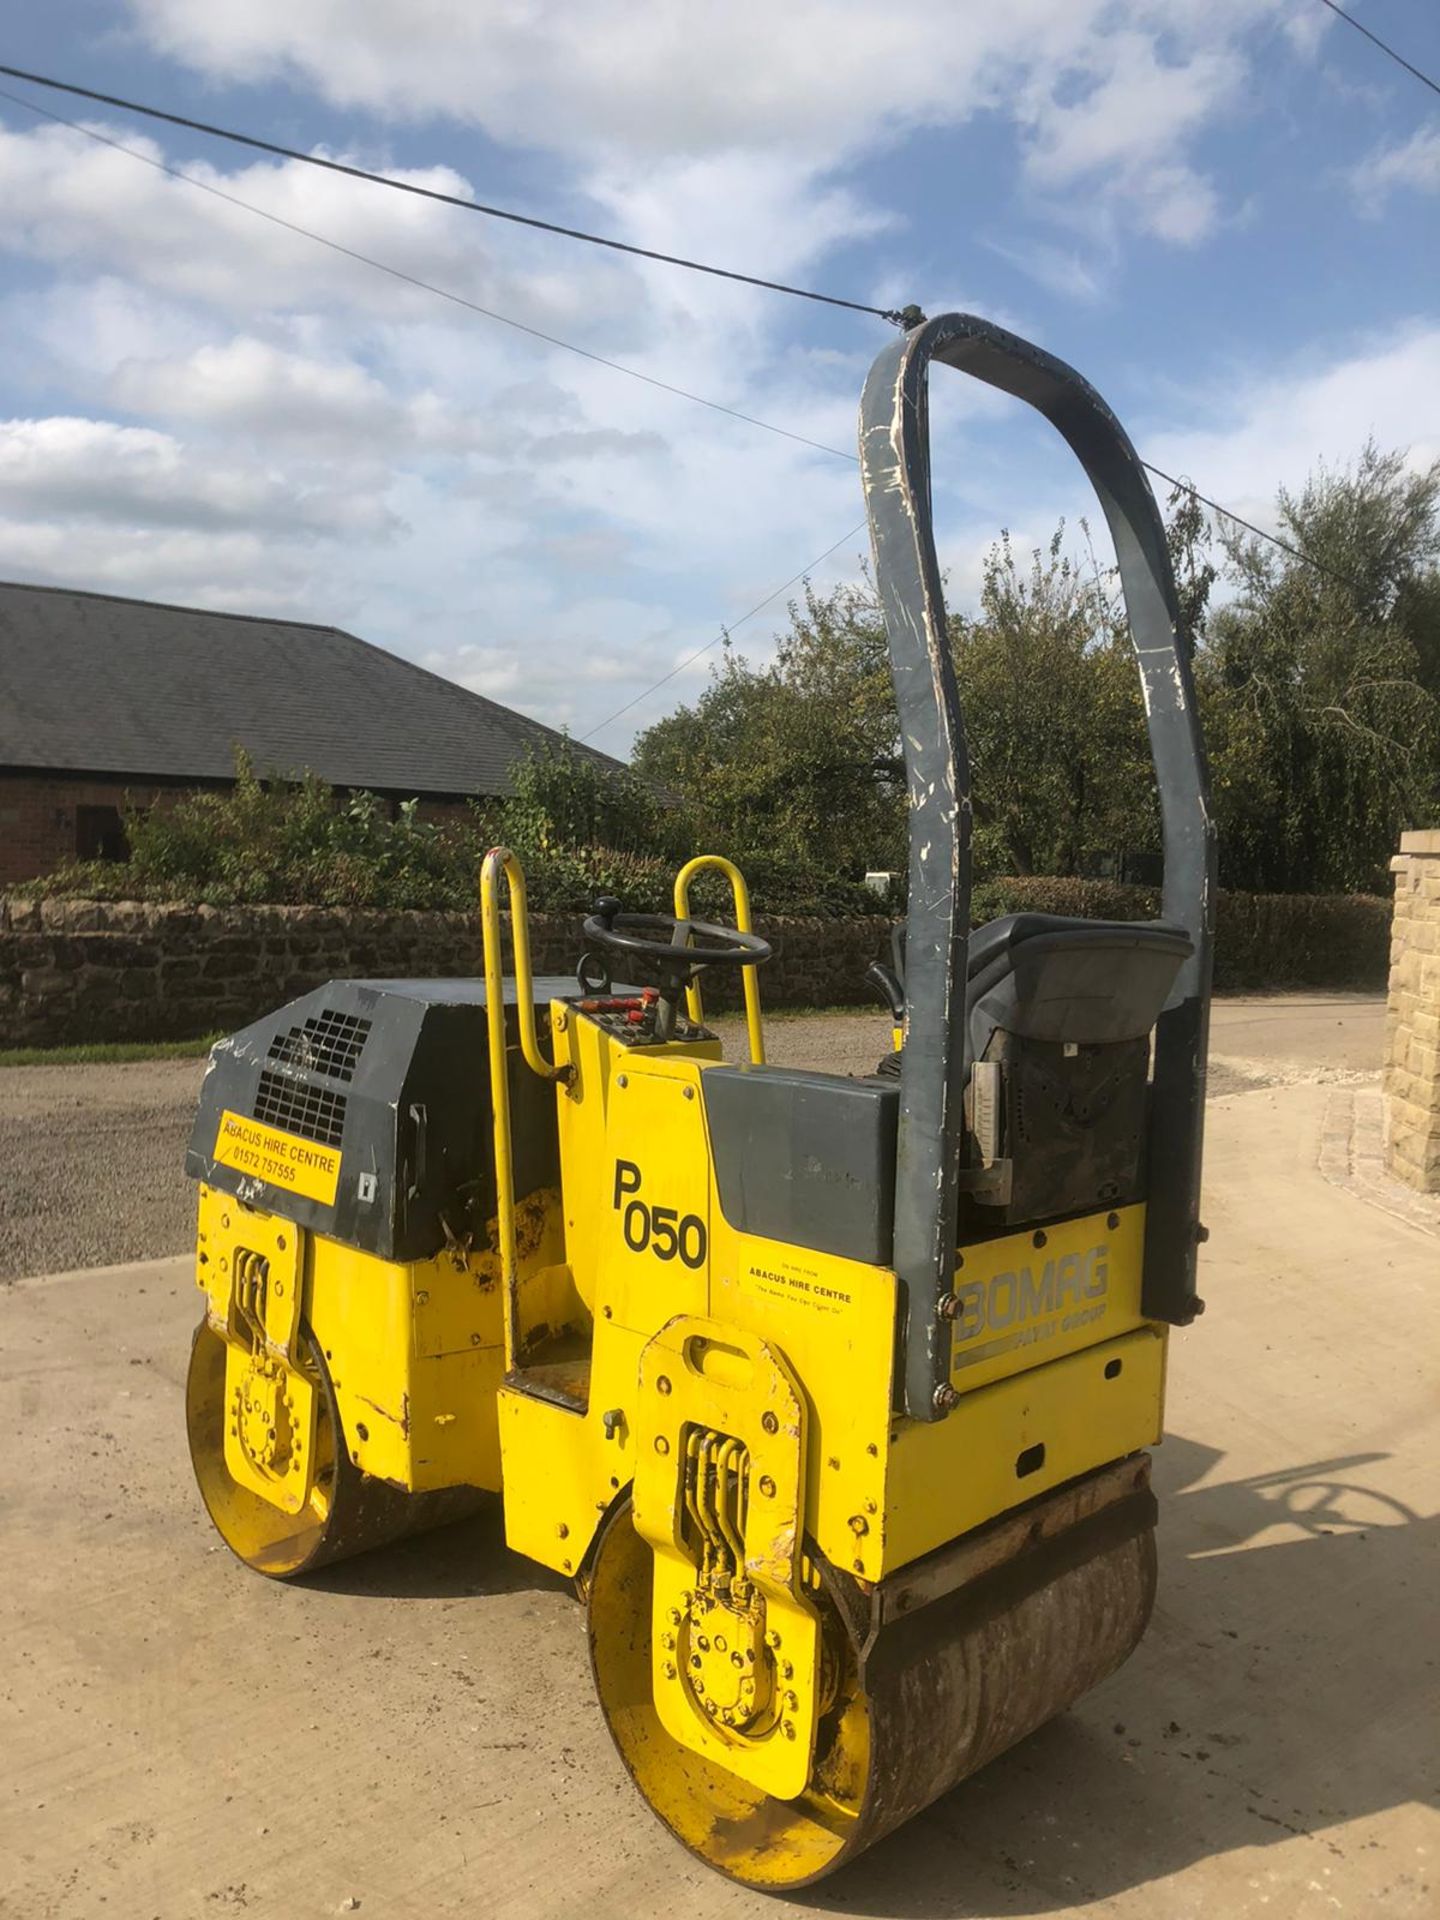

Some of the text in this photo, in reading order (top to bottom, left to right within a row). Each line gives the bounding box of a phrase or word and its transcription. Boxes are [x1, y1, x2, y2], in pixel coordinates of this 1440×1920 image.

[224, 1121, 335, 1174] ABACUS HIRE CENTRE
[233, 1147, 296, 1182] 01572 757555
[614, 1158, 642, 1210] P
[624, 1200, 707, 1269] 050
[749, 1267, 852, 1303] ABACUS HIRE CENTRE
[956, 1244, 1109, 1343] BOMAG
